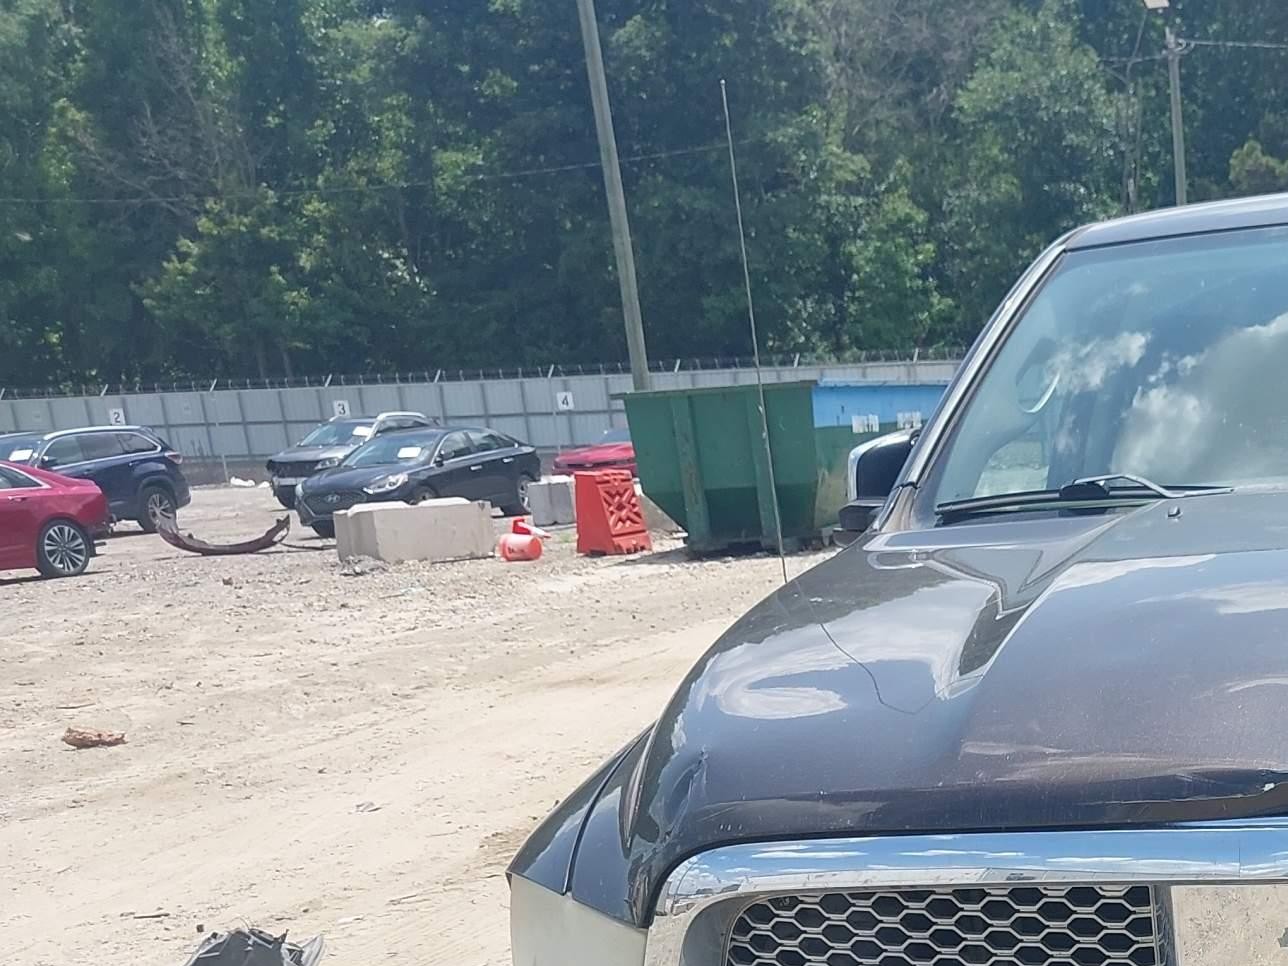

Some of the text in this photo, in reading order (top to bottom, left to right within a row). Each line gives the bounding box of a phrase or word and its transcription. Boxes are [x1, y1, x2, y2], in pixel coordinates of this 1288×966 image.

[562, 394, 569, 407] 4
[338, 403, 346, 415] 3
[113, 412, 121, 423] 2
